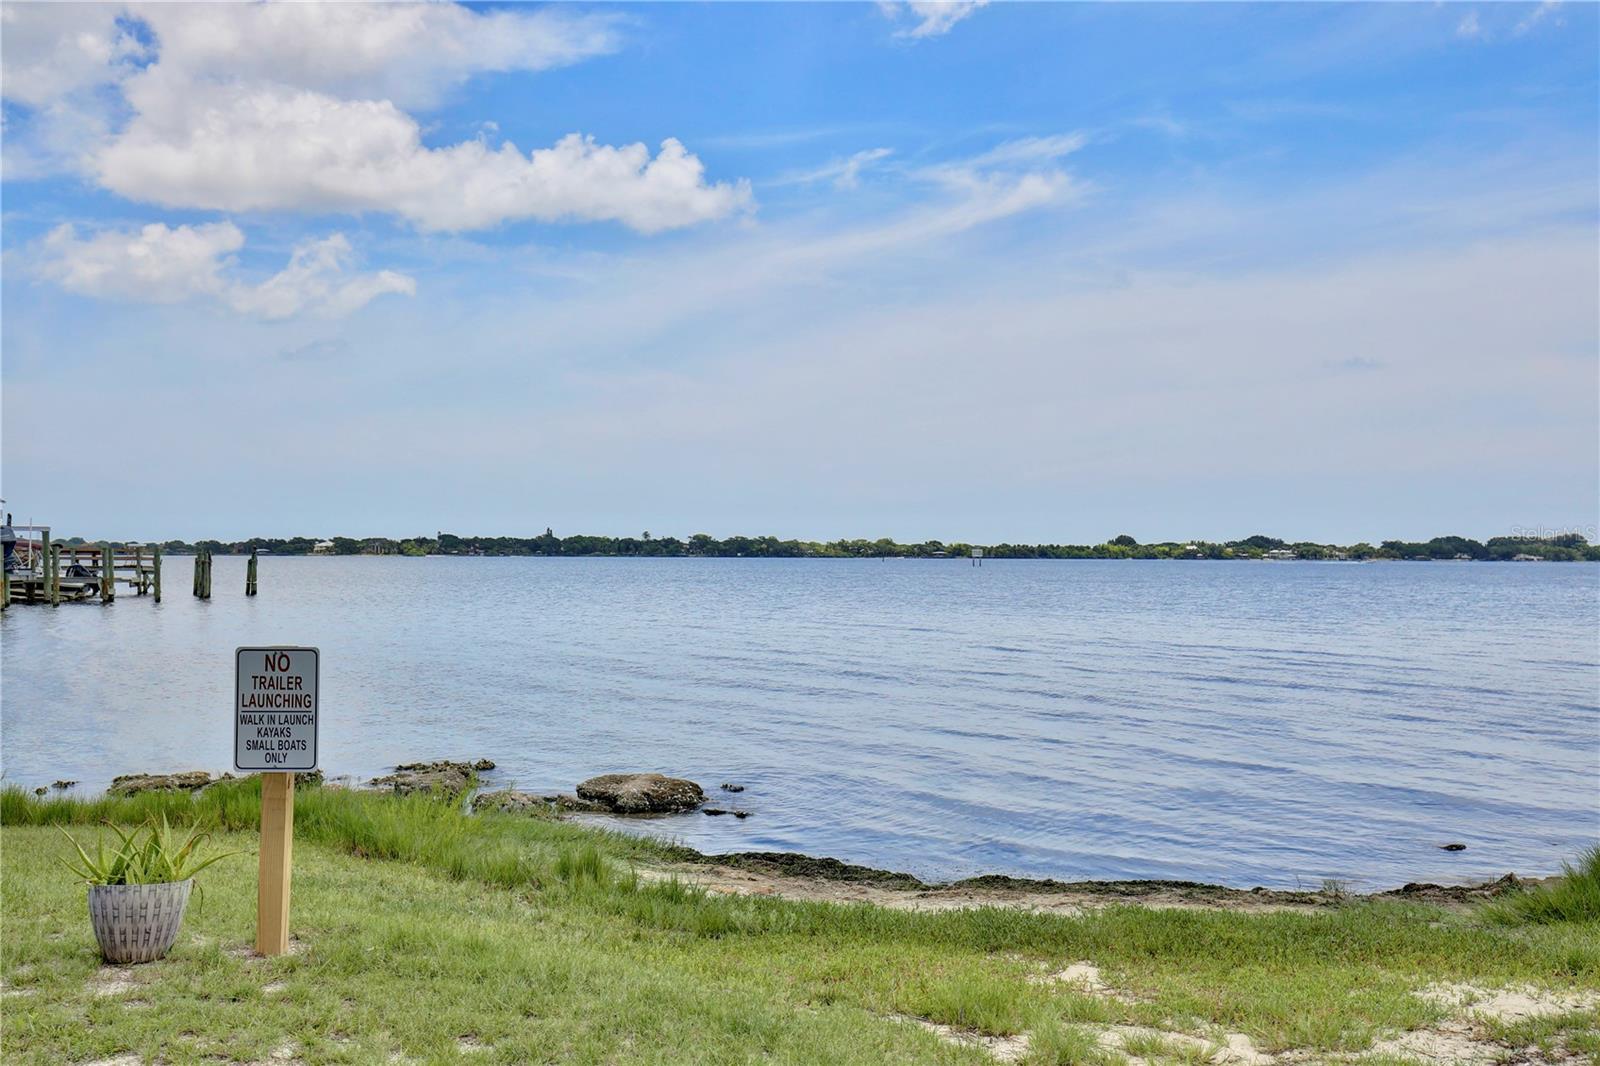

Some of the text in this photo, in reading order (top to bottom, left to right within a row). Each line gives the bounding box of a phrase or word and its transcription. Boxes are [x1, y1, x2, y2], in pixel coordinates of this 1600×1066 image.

[265, 654, 290, 672] NO
[252, 676, 303, 691] TRAILER
[241, 693, 312, 708] LAUNCHING
[240, 714, 314, 725] WALK IN LAUNCH
[257, 727, 291, 738] KAYAKS
[246, 739, 307, 751] SMALL BOATS
[265, 752, 288, 763] ONLY
